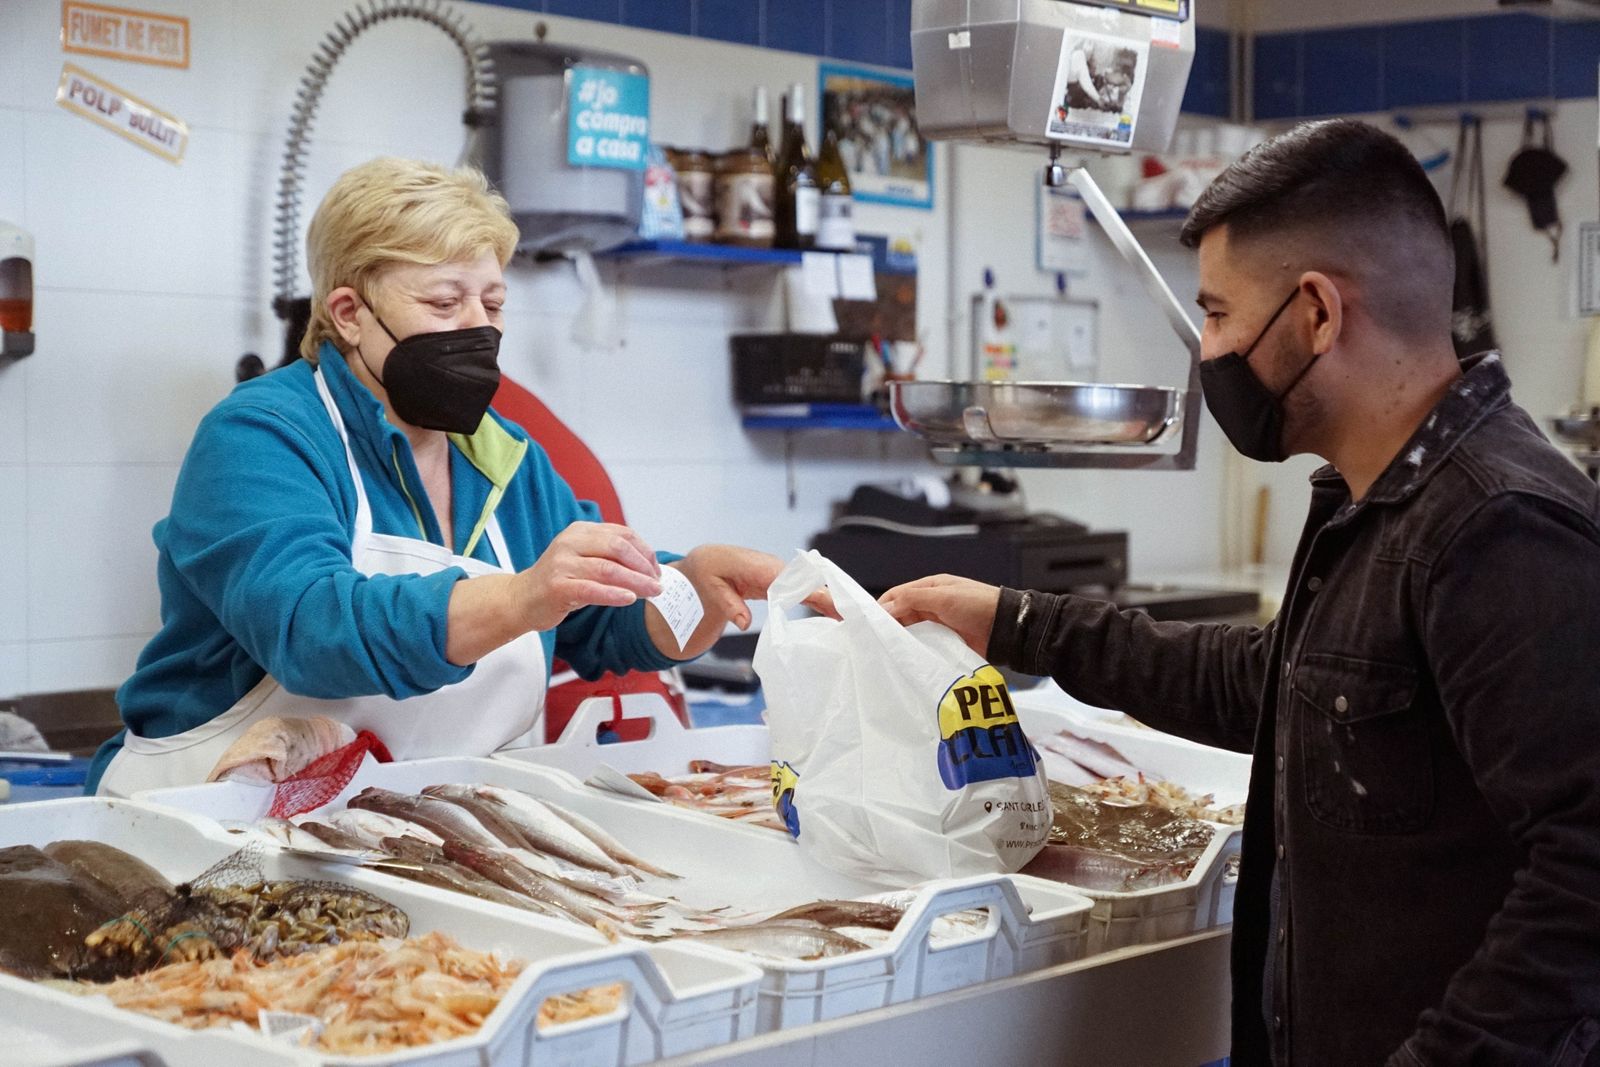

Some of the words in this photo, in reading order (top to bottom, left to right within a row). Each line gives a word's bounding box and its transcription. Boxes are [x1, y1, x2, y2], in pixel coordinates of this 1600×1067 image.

[71, 11, 121, 47] FUMET
[126, 20, 144, 50] DE
[578, 79, 618, 110] #jo
[69, 79, 122, 116] POLP
[129, 113, 177, 146] BULLIT
[576, 110, 647, 139] compra
[575, 136, 594, 157] a
[597, 138, 640, 161] casa
[997, 801, 1019, 813] SANT
